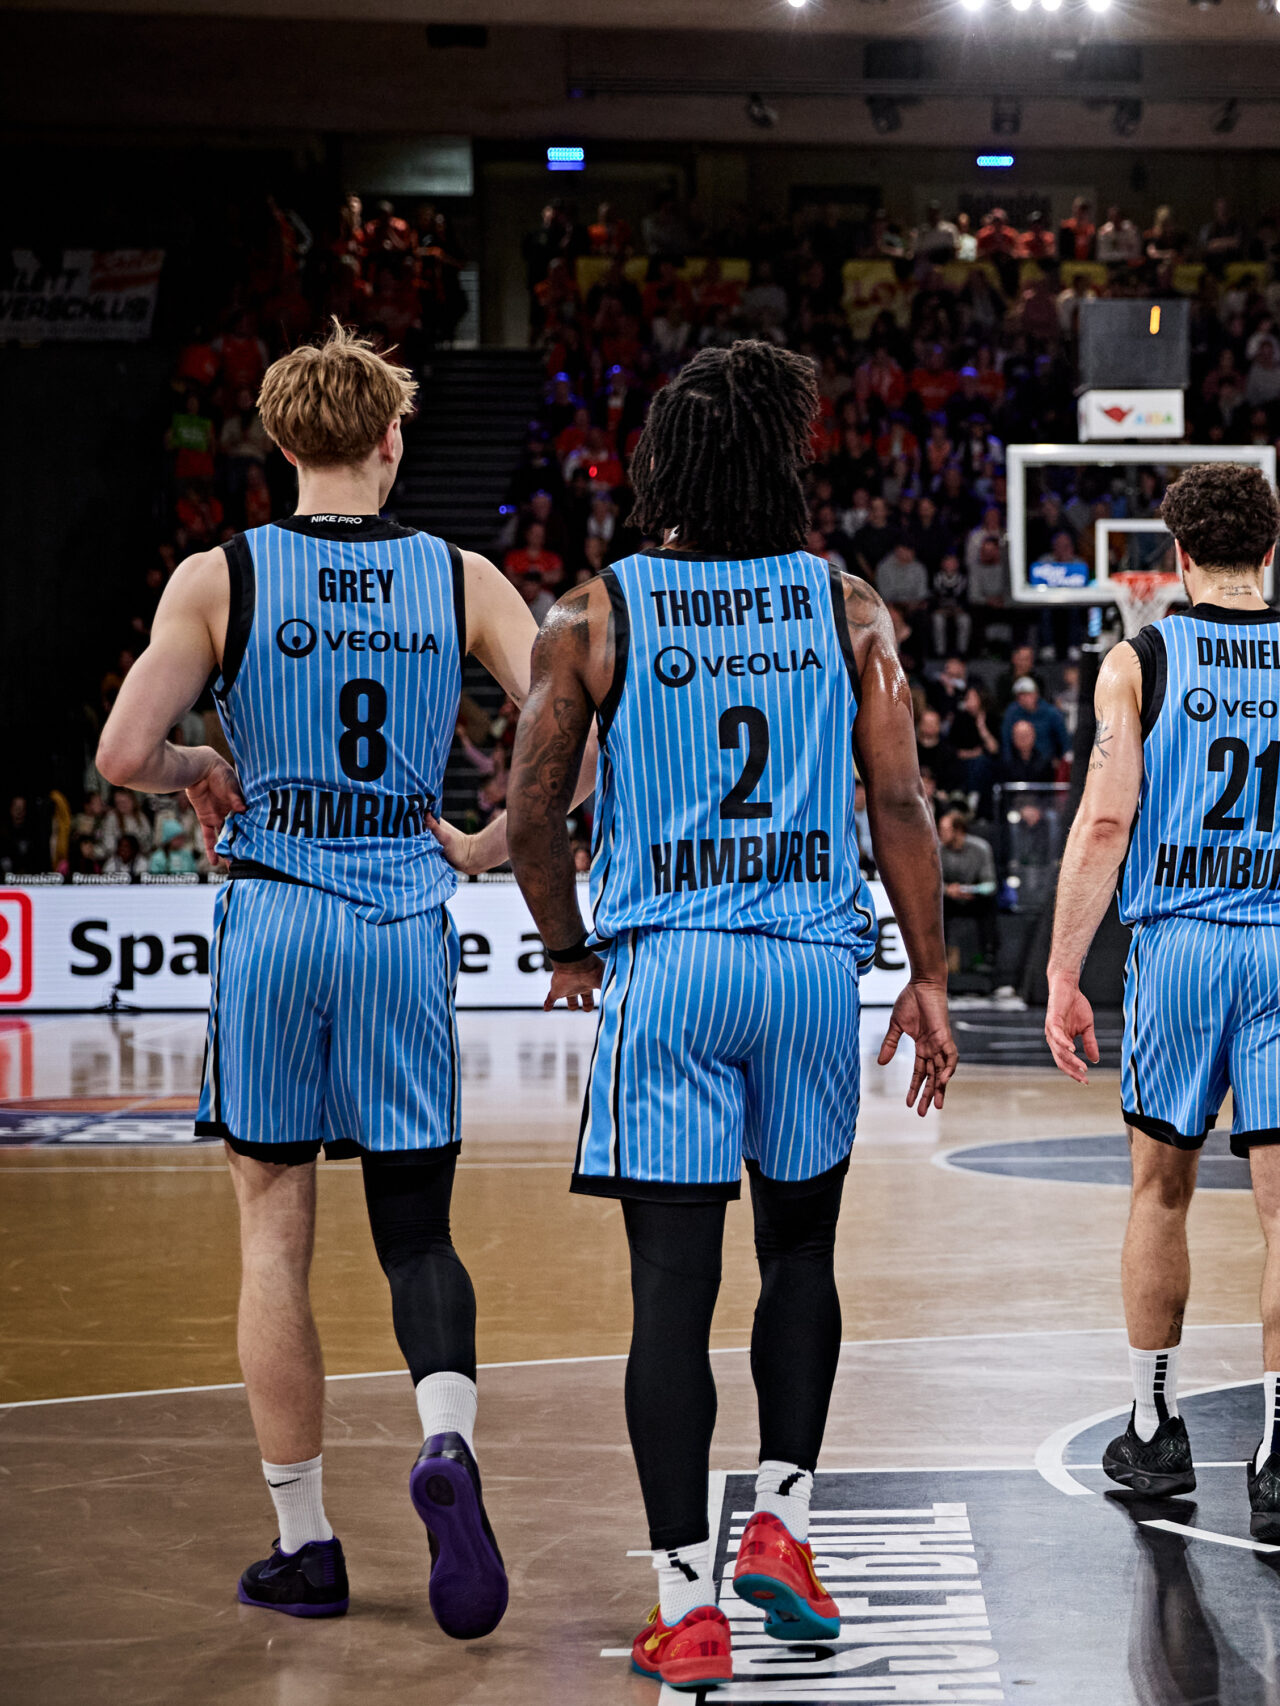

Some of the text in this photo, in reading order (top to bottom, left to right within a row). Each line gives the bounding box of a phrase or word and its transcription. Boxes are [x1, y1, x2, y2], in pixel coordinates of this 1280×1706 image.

[311, 514, 363, 524] NIKE PRO
[318, 567, 394, 604] GREY
[651, 584, 813, 627] THORPE JR
[324, 629, 439, 655] VEOLIA
[702, 648, 823, 678] VEOLIA
[338, 677, 388, 783] 8
[718, 705, 773, 820] 2
[1203, 736, 1280, 833] 21
[651, 830, 830, 896] HAMBURG
